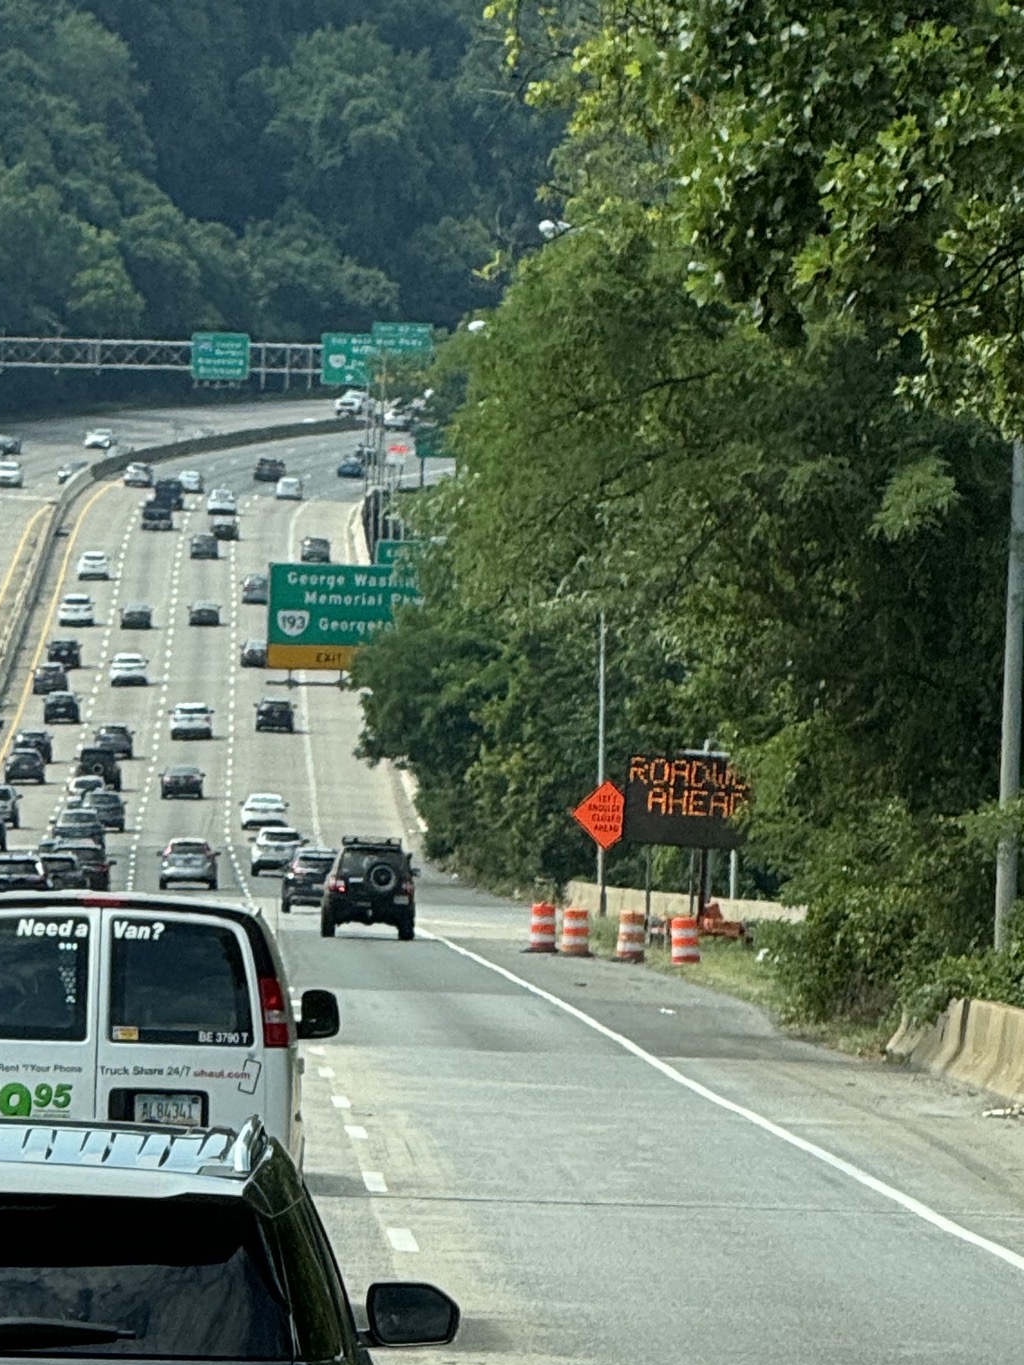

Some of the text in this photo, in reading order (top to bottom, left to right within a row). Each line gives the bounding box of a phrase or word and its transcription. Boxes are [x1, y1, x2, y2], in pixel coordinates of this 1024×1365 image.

[287, 572, 419, 588] George Washin
[304, 591, 426, 606] Memorial Pkw
[281, 615, 306, 630] 193
[318, 617, 395, 635] Georgeto
[315, 652, 343, 663] EXIT
[647, 787, 749, 819] AHEAD
[16, 918, 166, 941] Need a Van?
[197, 1031, 213, 1042] BE
[241, 1033, 249, 1043] T
[53, 1064, 83, 1073] Phone
[99, 1065, 191, 1077] Truck Share 24/7
[193, 1069, 251, 1080] uhaul.com
